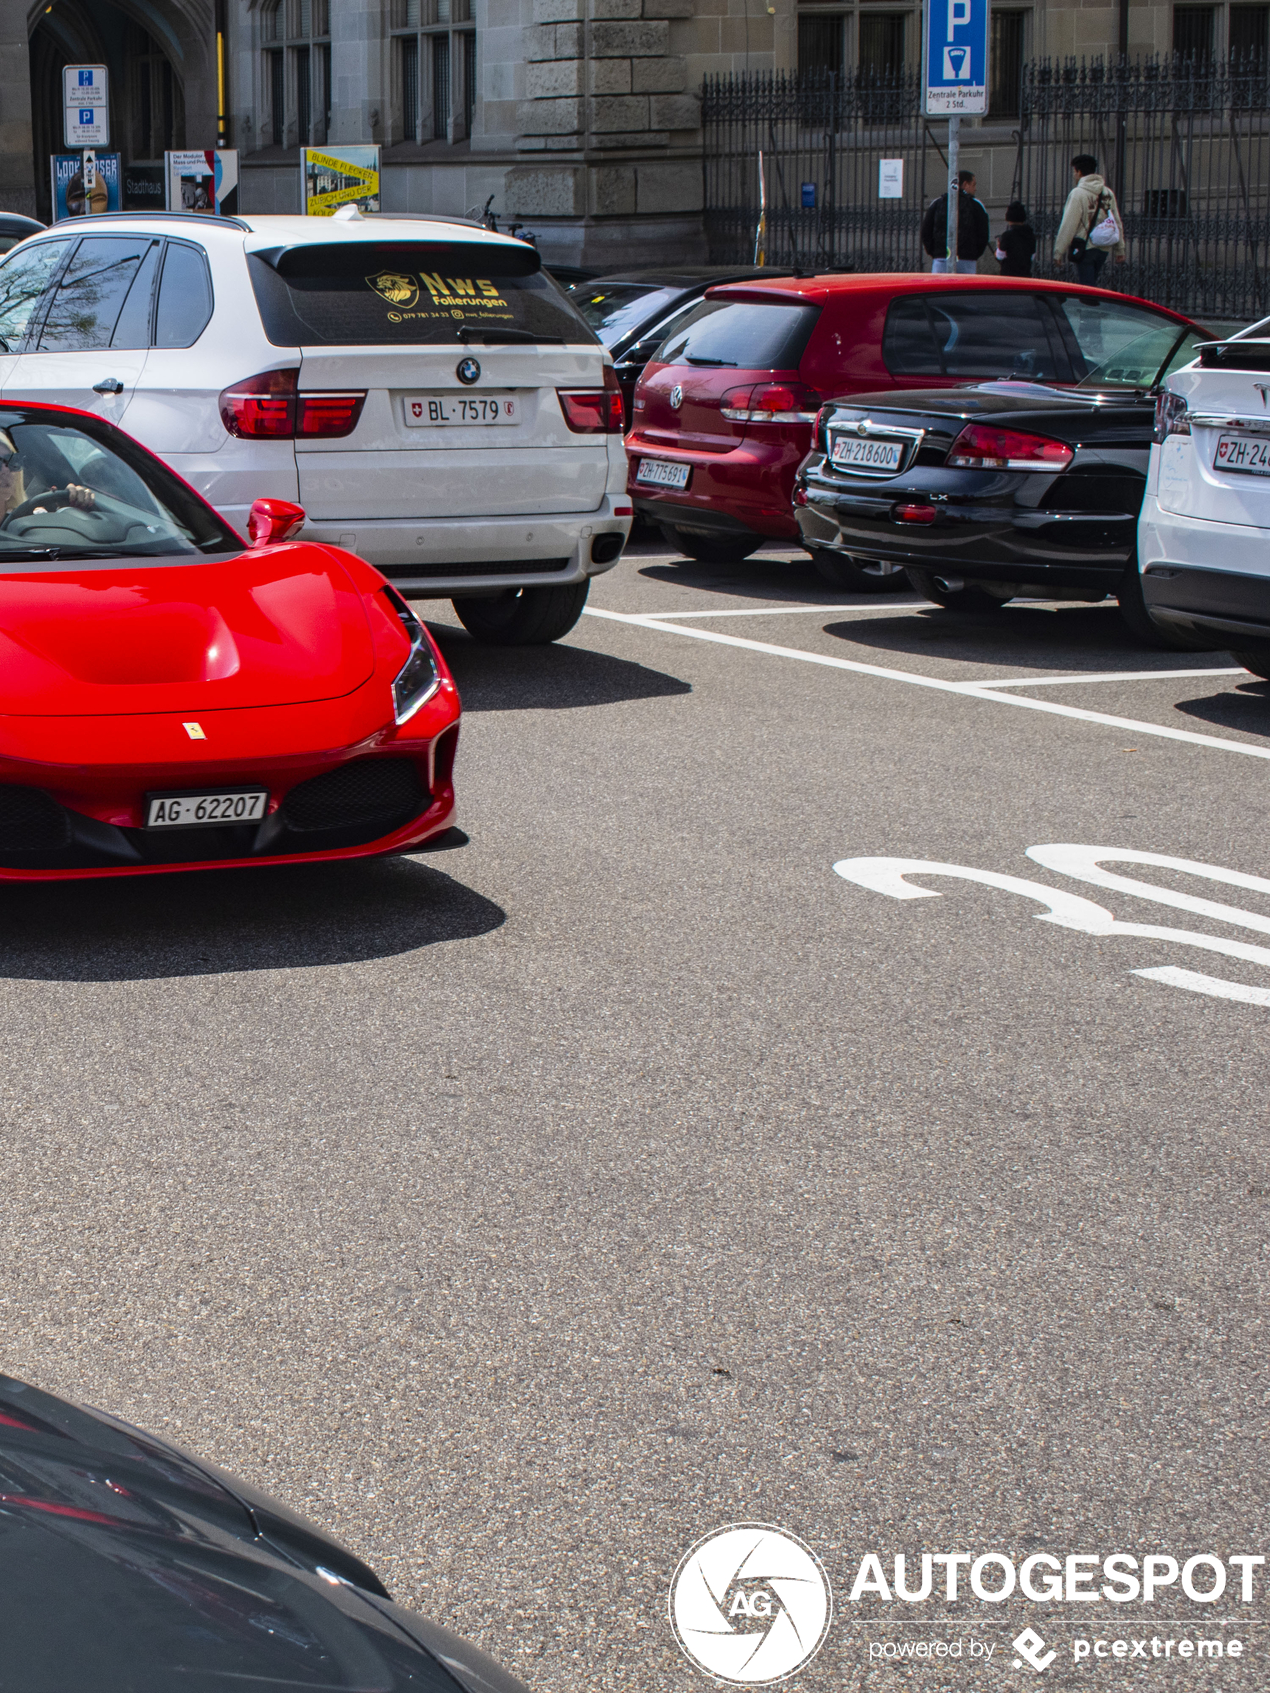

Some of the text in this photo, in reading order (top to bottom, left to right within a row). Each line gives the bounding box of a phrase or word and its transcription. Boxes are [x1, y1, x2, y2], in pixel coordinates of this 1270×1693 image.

[947, 0, 972, 43] P
[928, 89, 984, 99] Zentrale Parkuhr
[83, 111, 90, 123] P
[311, 152, 374, 180] BLINDE FLECKEN
[126, 178, 162, 195] Stadthaus
[338, 188, 356, 200] UND
[356, 185, 372, 195] DER
[432, 295, 508, 308] Folierungen
